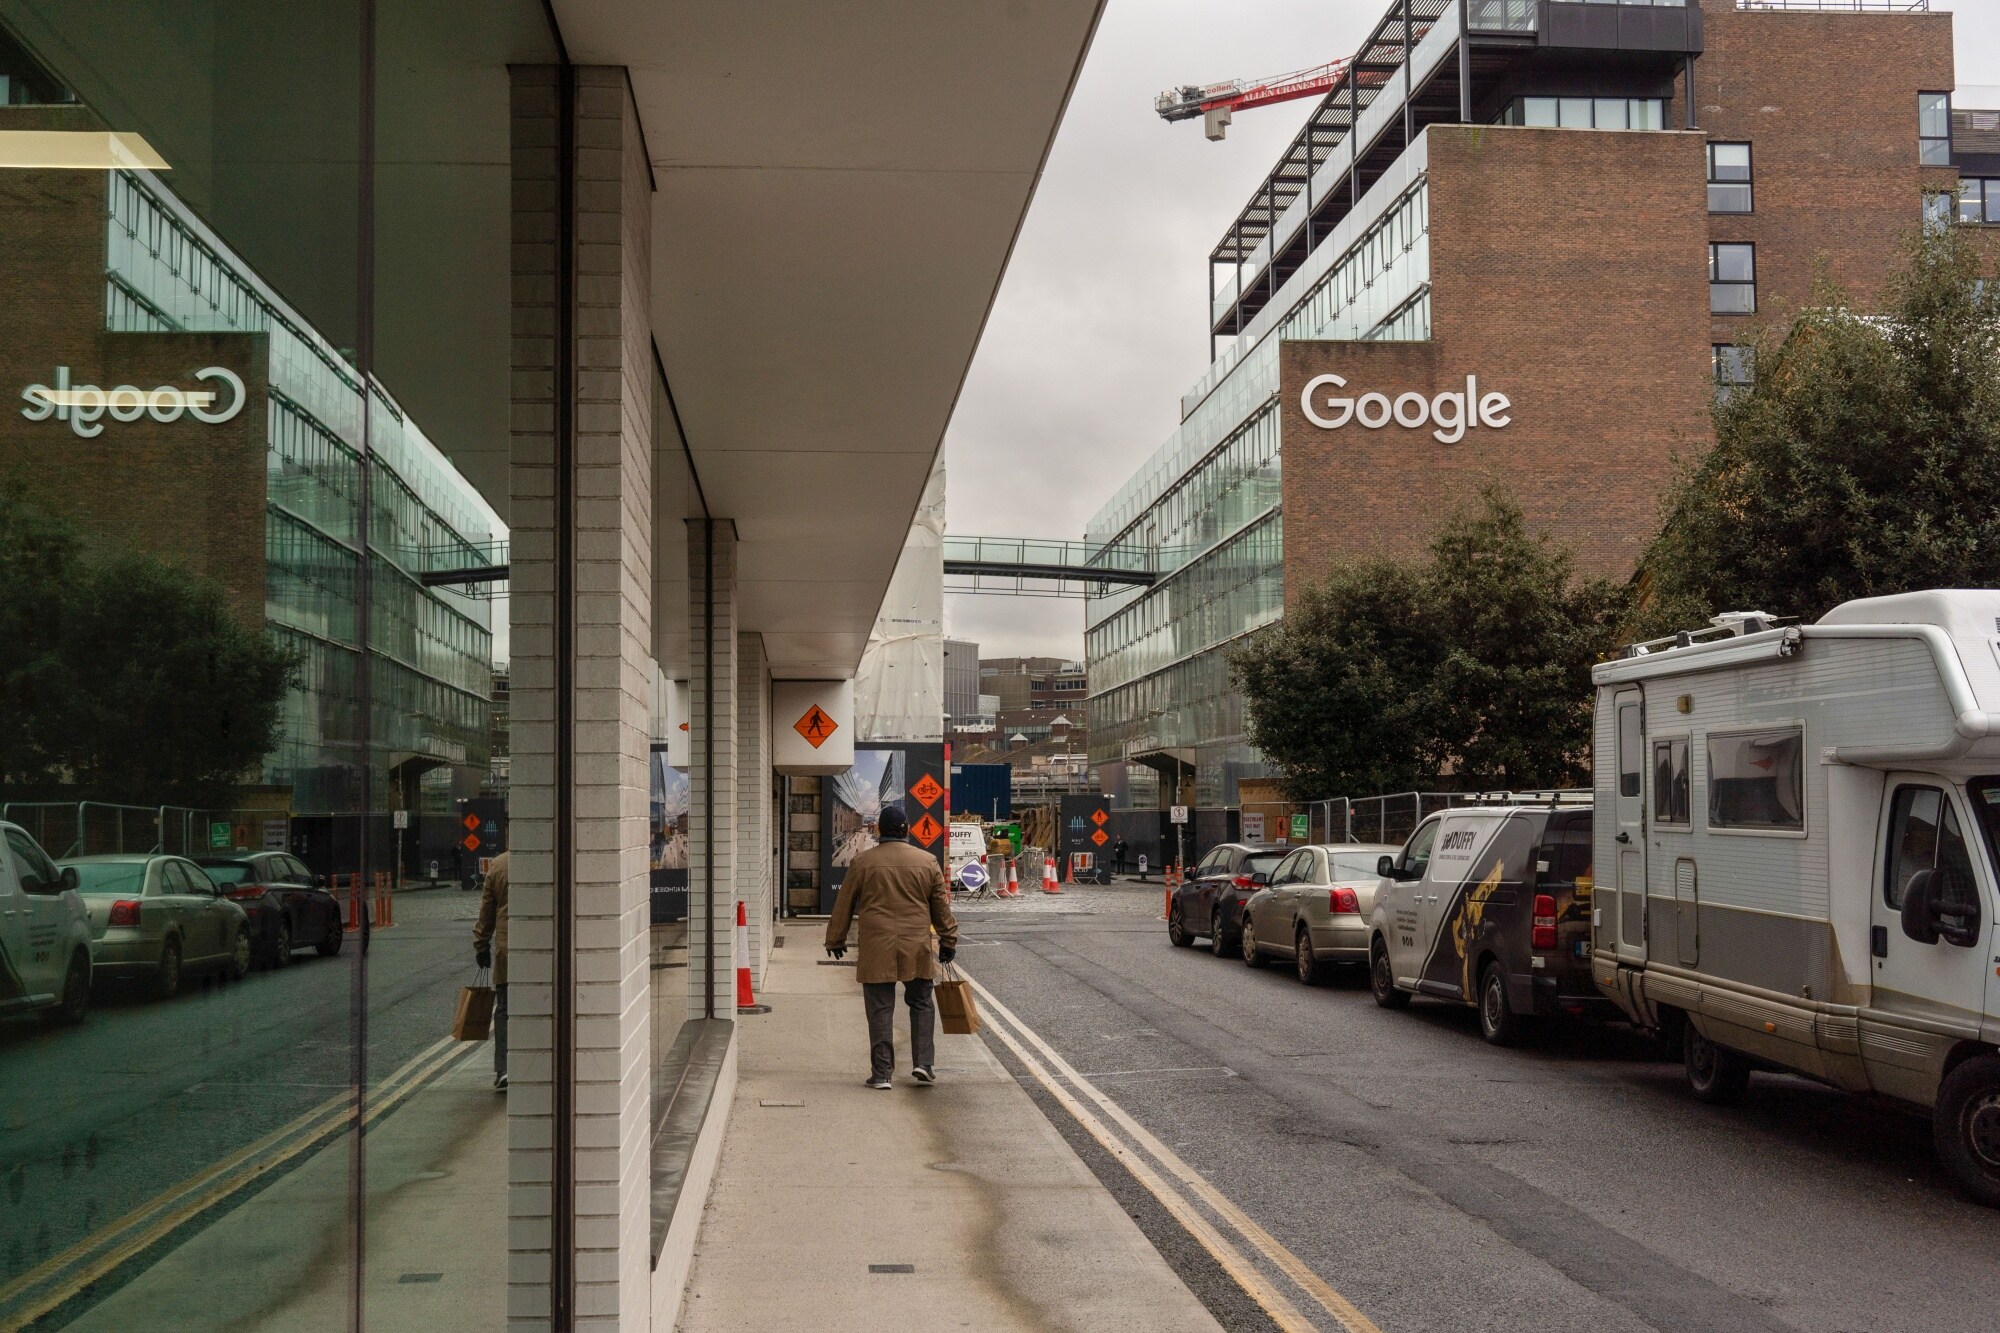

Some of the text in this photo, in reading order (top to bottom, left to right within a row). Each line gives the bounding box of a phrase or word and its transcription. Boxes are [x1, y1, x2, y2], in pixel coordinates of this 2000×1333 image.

[1207, 84, 1232, 95] collen
[1243, 75, 1337, 102] ALLEN CRANES LTD
[1300, 373, 1512, 444] Google
[1450, 831, 1477, 850] DUFFY
